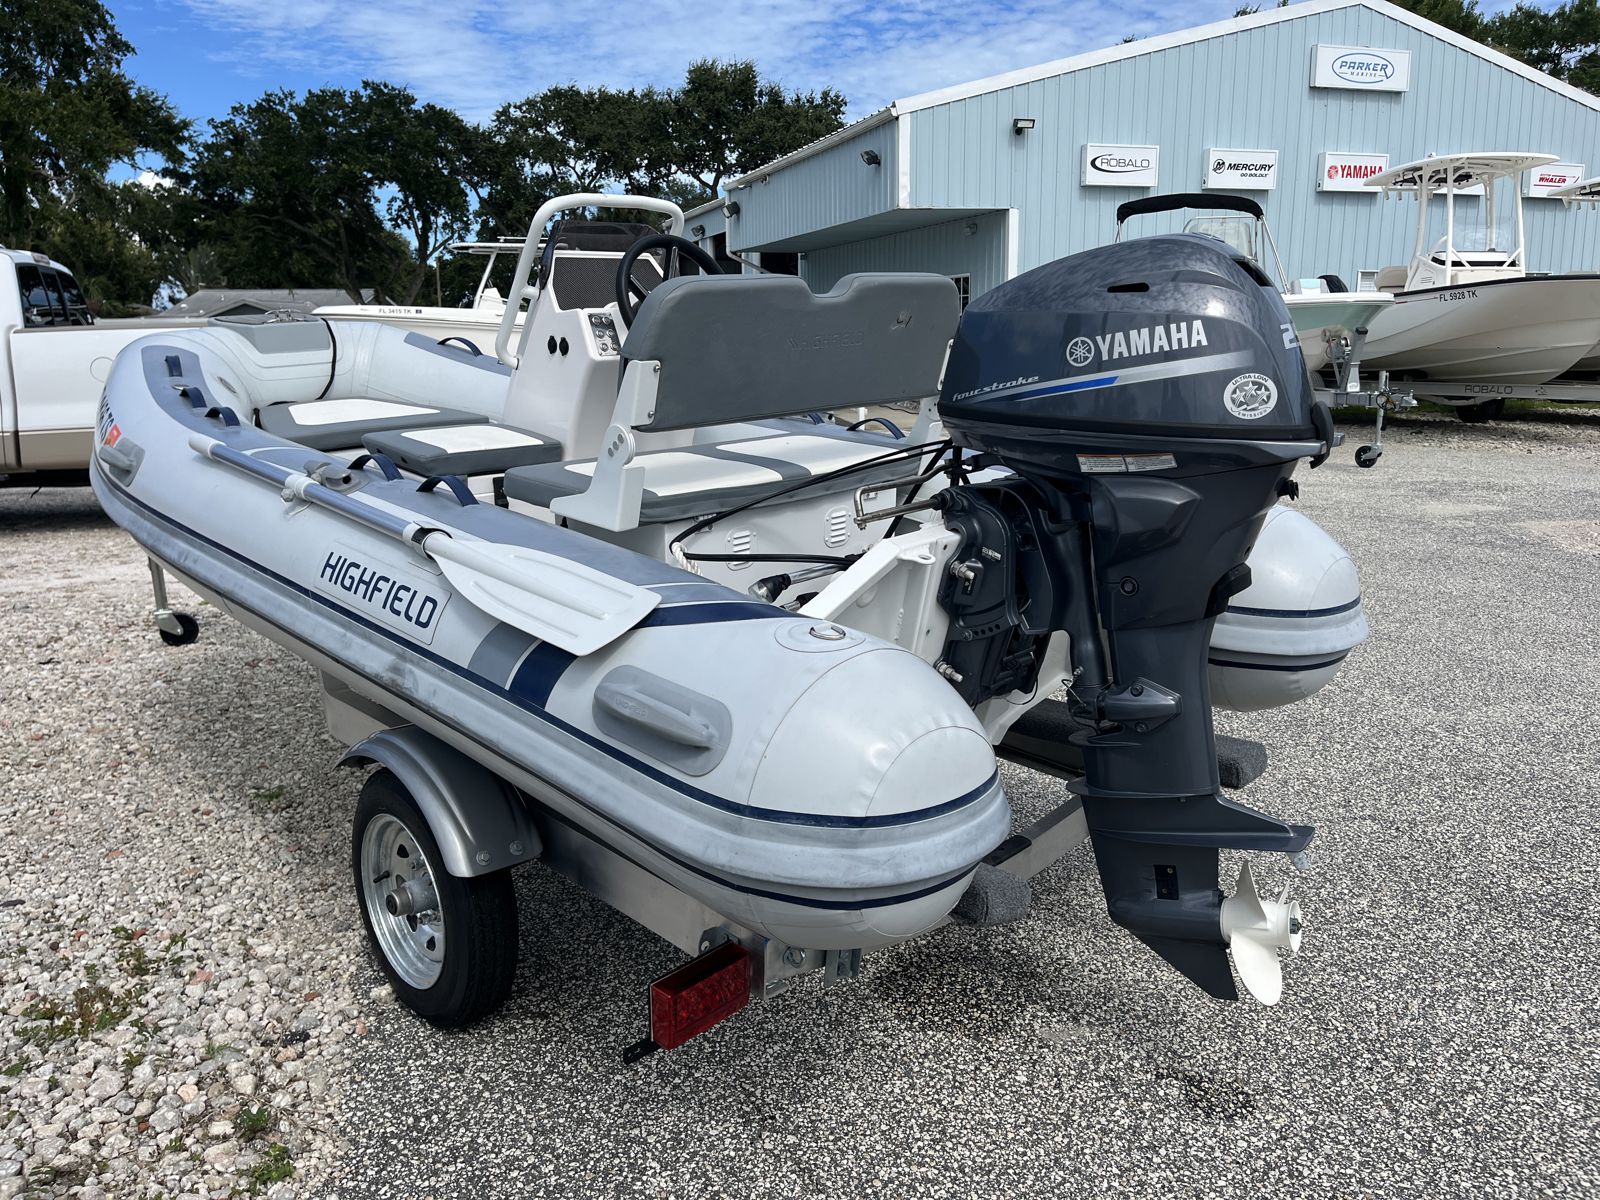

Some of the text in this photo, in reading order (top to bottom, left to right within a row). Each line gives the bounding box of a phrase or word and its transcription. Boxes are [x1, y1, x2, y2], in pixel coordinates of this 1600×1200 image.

[1339, 60, 1389, 76] PARKER
[1100, 157, 1150, 169] ROBALO
[1226, 163, 1275, 172] MERCURY
[1439, 289, 1478, 302] FL 5928 TK
[1095, 319, 1209, 361] YAMAHA
[1231, 374, 1269, 386] ULTRA LOW
[1464, 384, 1513, 395] ROBALO
[320, 551, 438, 629] HIGHFIELD
